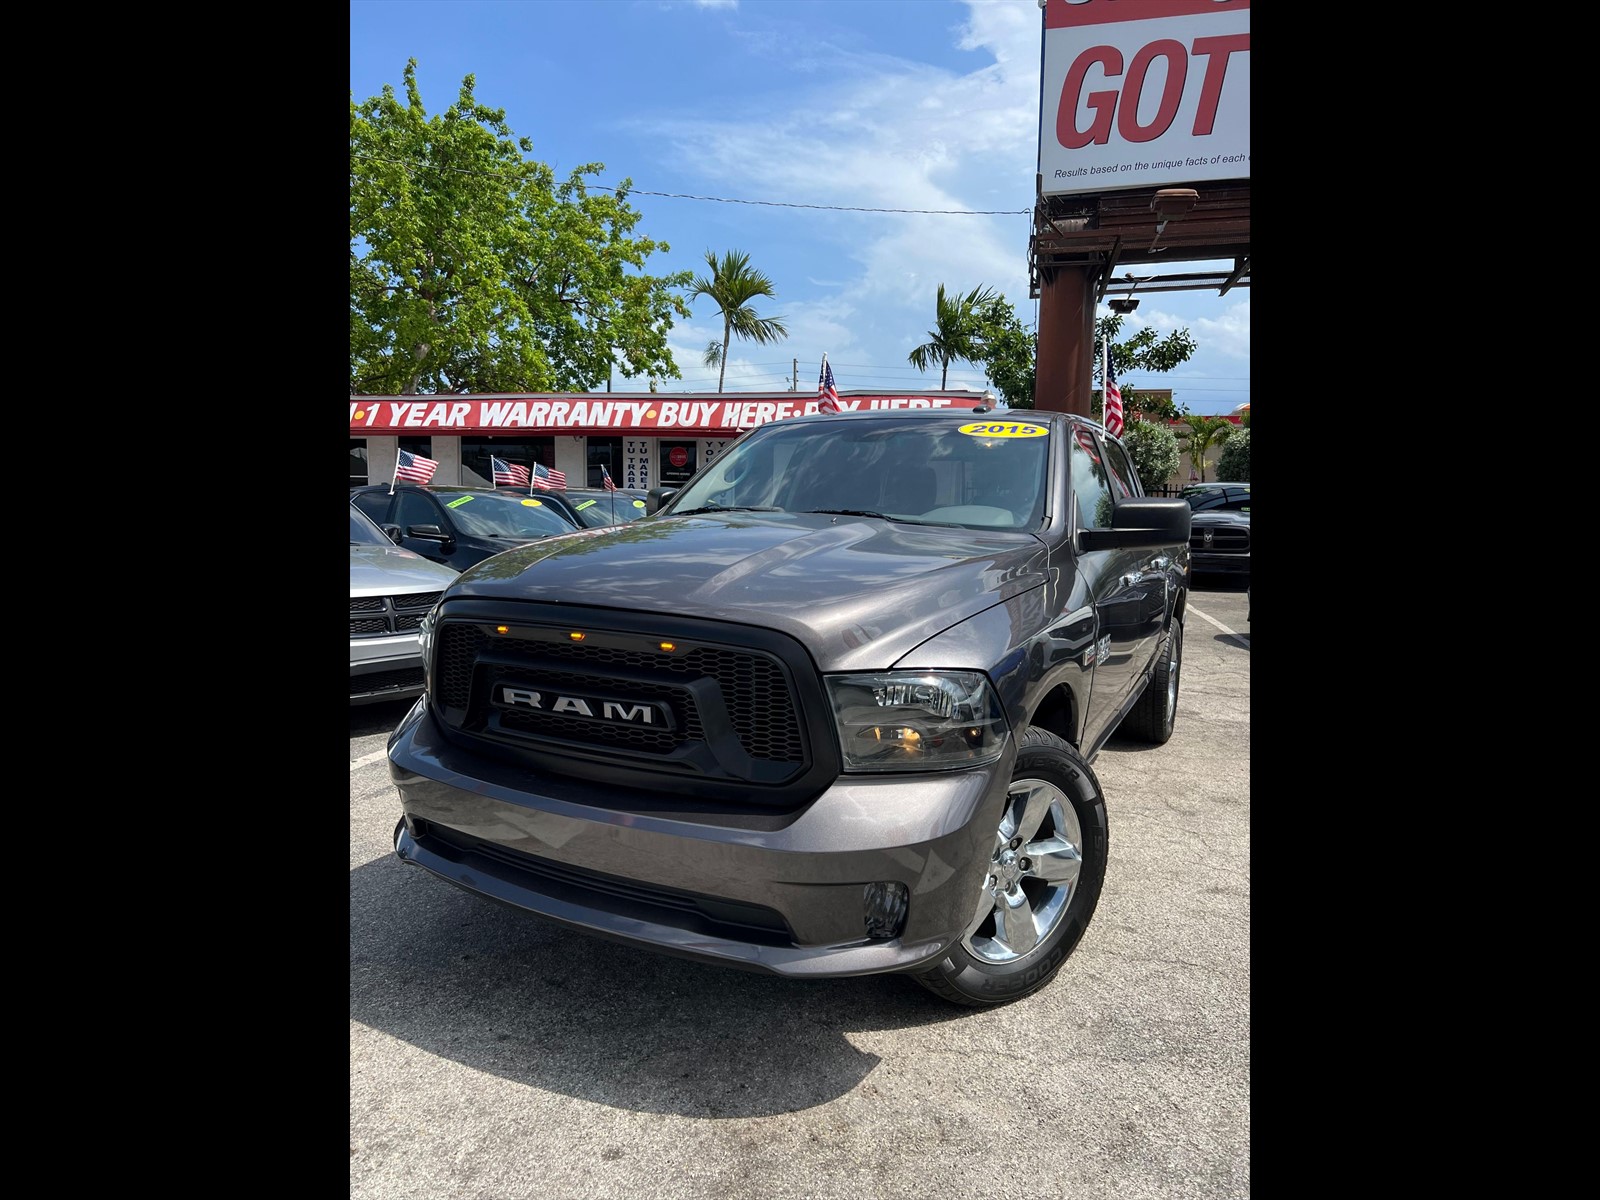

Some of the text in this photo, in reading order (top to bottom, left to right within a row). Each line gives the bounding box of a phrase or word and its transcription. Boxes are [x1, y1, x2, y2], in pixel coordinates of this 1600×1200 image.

[1055, 33, 1250, 150] GOT
[1054, 167, 1088, 178] Results
[1090, 164, 1119, 175] based
[1120, 163, 1132, 172] on
[1134, 161, 1149, 171] the
[1151, 159, 1183, 170] unique
[1185, 157, 1208, 166] facts
[1210, 154, 1221, 164] of
[1222, 153, 1246, 163] each
[365, 403, 381, 426] 1
[389, 403, 471, 427] YEAR
[479, 402, 652, 427] WARRANTY
[657, 402, 720, 427] BUY
[721, 402, 794, 427] HERE
[969, 425, 1038, 435] 2015
[627, 441, 636, 454] TU
[639, 441, 648, 454] TU
[503, 687, 652, 724] RAM
